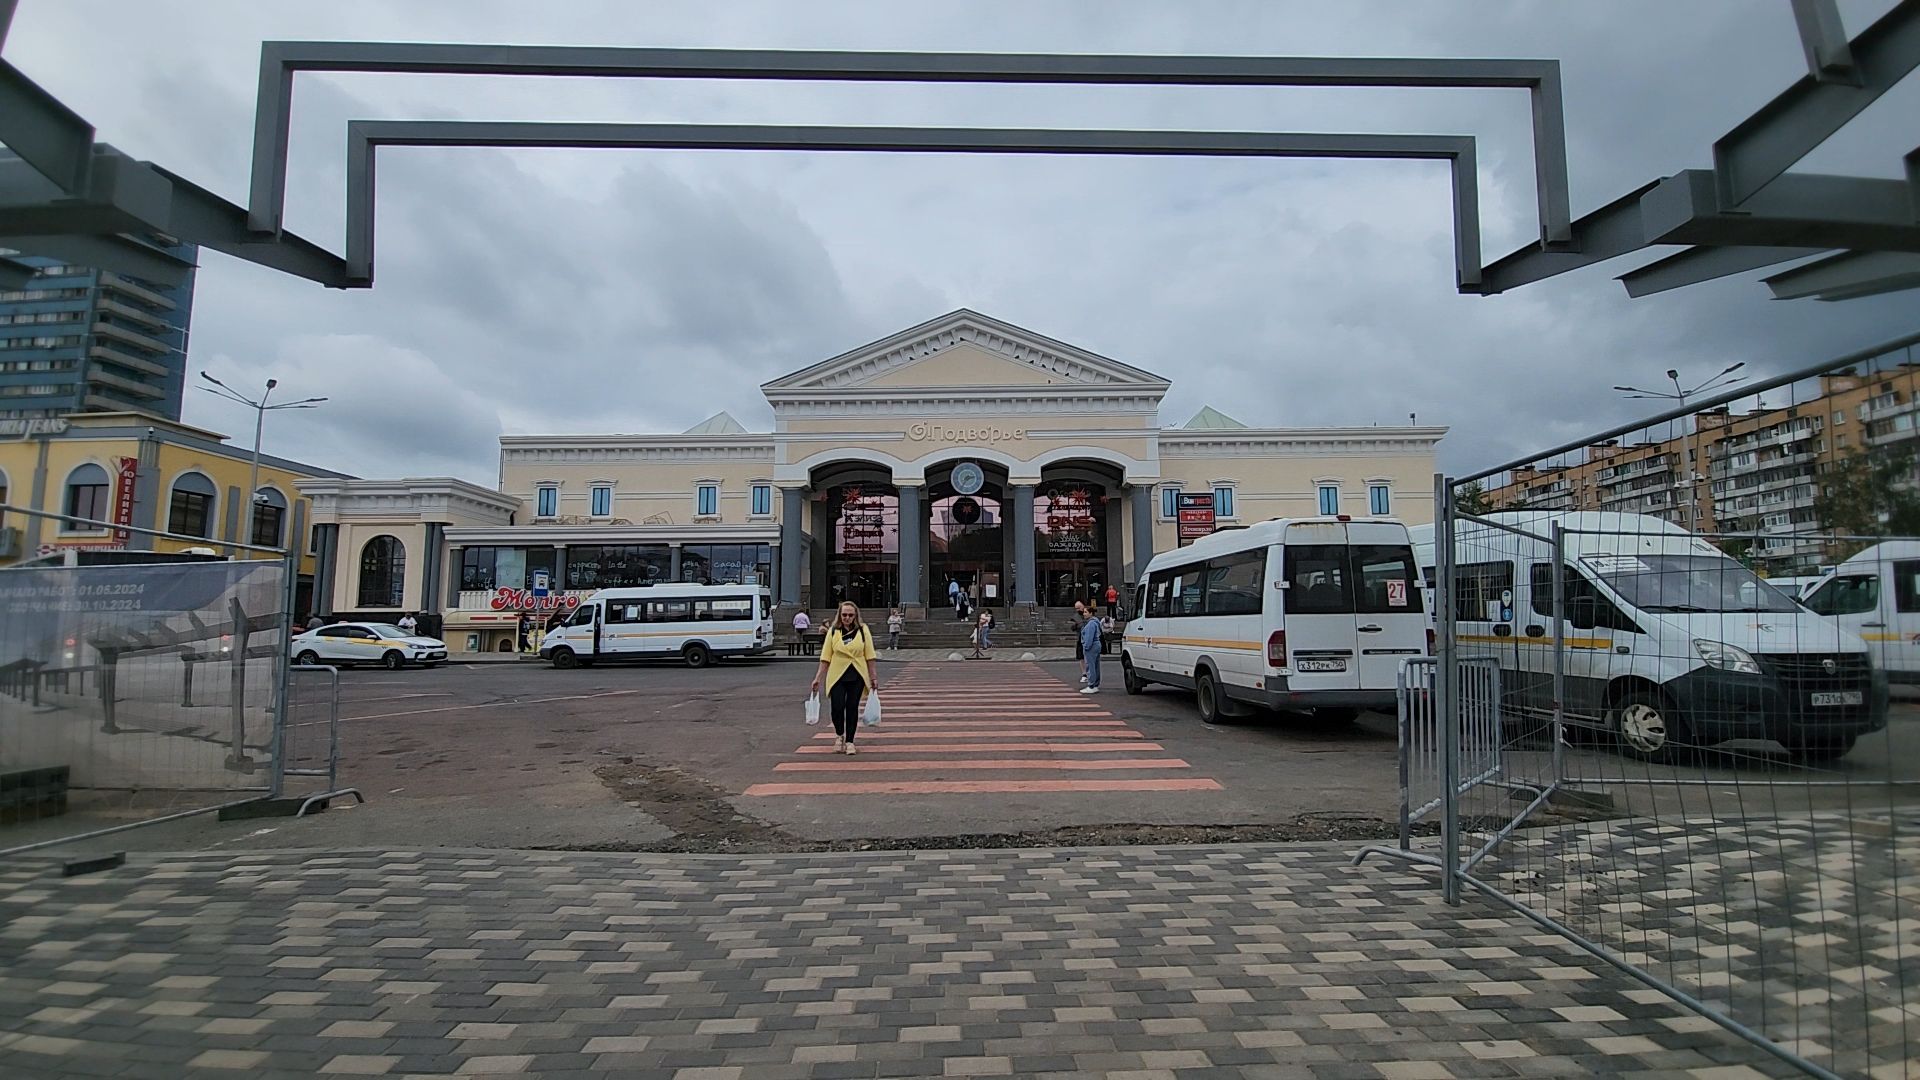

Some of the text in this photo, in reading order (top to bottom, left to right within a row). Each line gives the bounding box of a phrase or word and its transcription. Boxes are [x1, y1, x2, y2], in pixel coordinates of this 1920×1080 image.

[24, 417, 71, 440] JEANS
[119, 470, 135, 538] ЮВЕЛИРНЙ
[1047, 516, 1093, 527] DNS
[490, 586, 579, 610] Monro
[1389, 583, 1404, 598] 27
